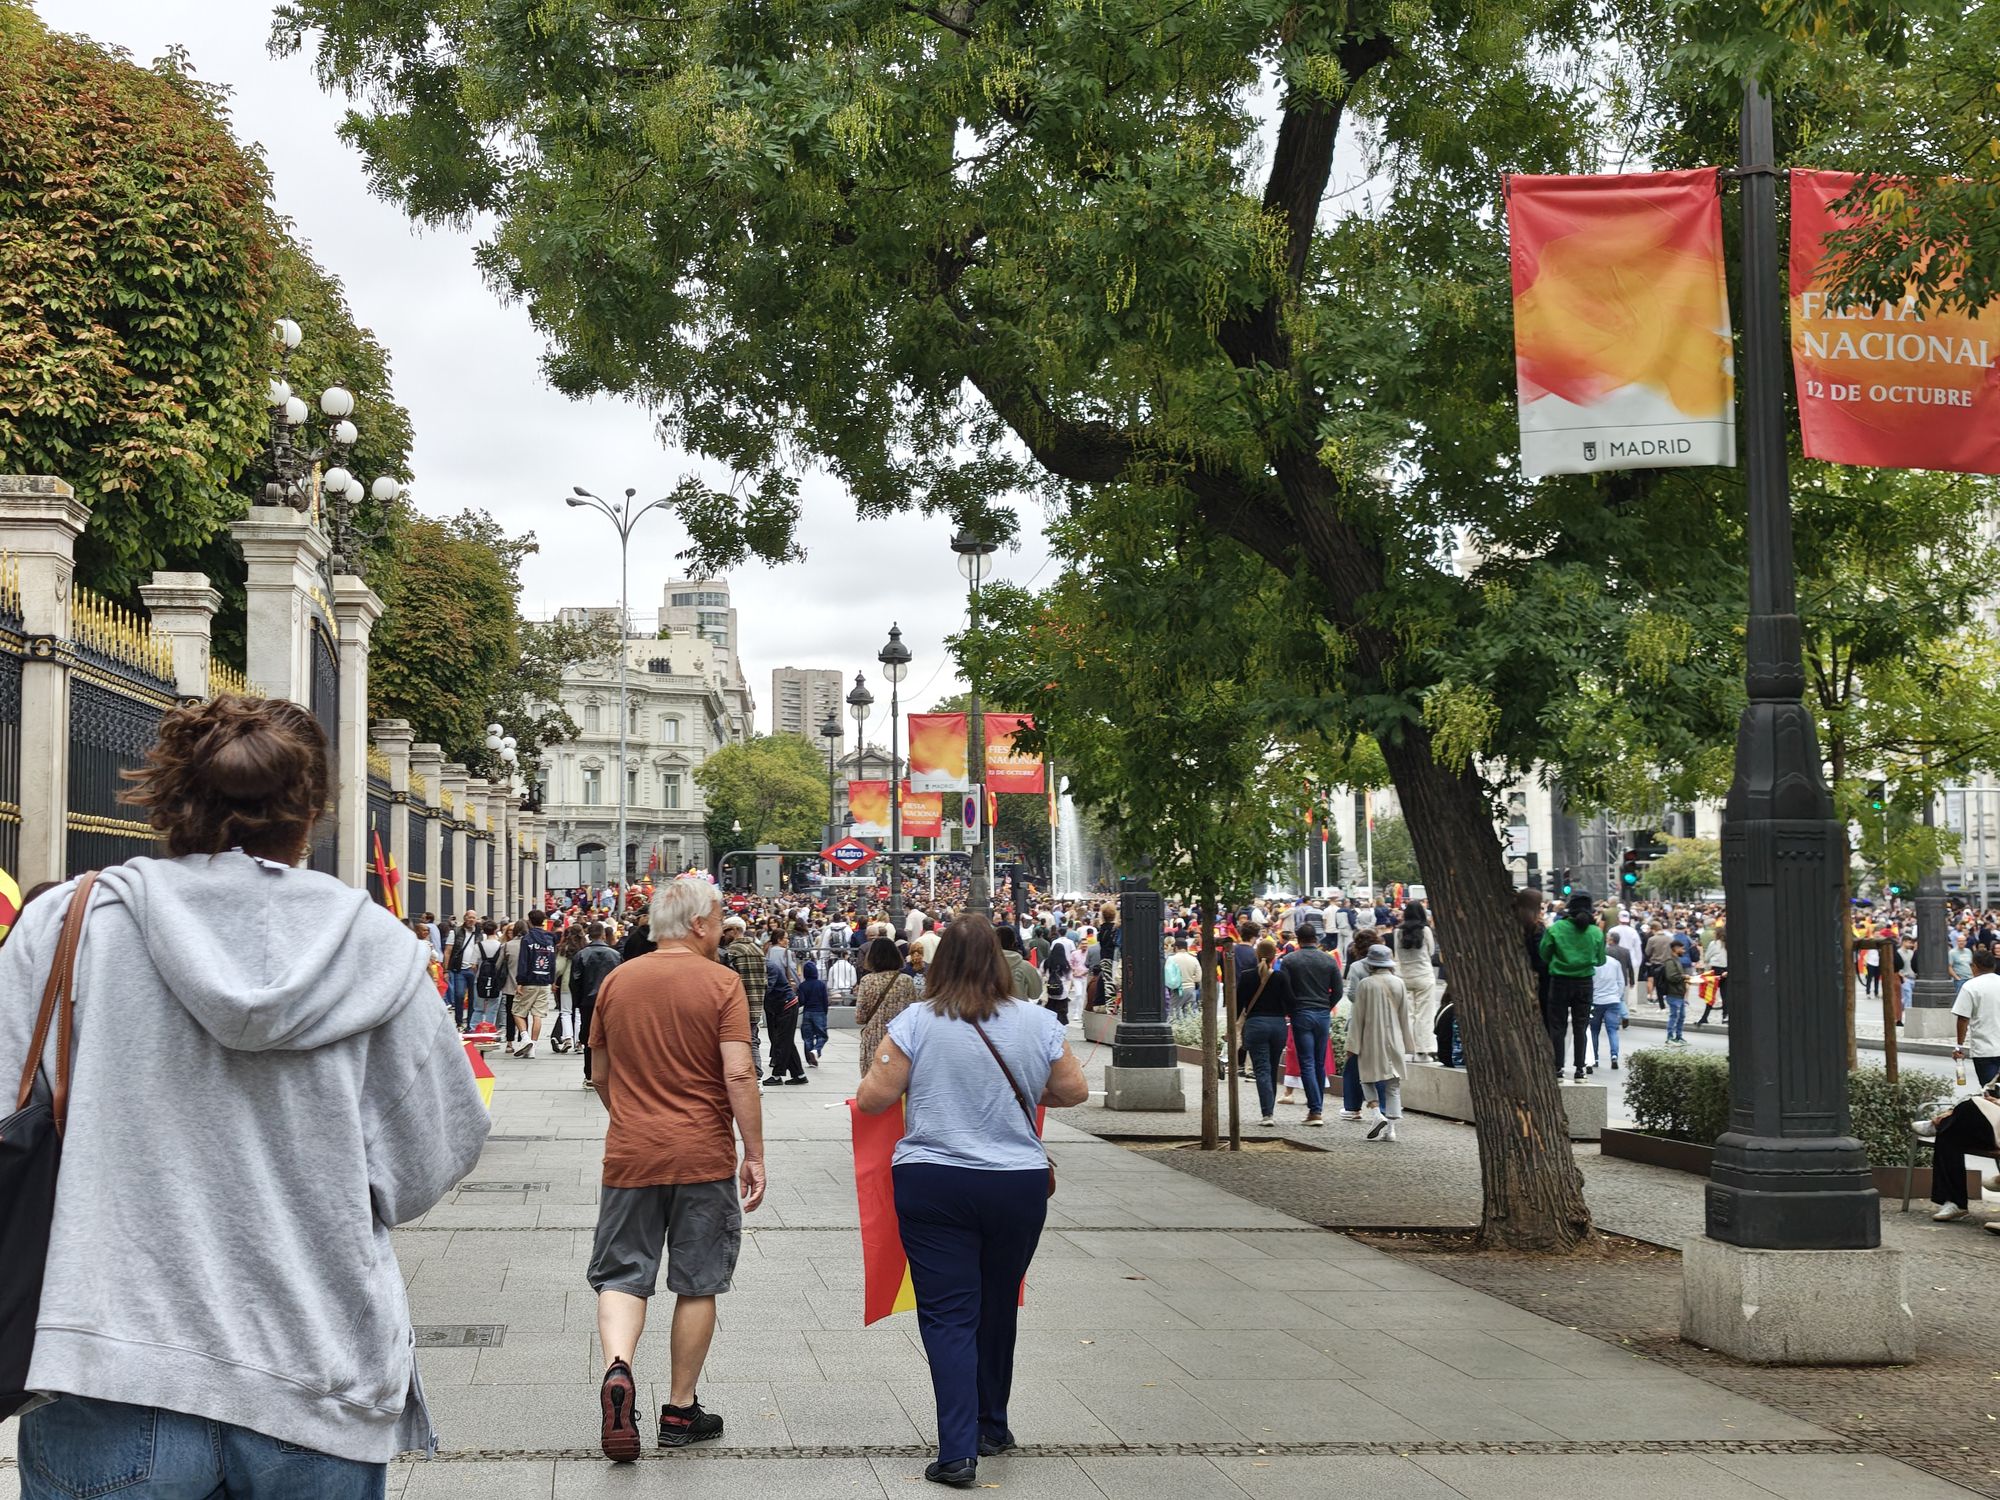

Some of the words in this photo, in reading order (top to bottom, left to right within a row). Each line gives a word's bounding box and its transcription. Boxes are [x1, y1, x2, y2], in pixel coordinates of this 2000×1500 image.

[1802, 331, 1996, 369] NACIONAL
[1805, 380, 1824, 399] 12
[1830, 383, 1862, 401] DE
[1868, 385, 1973, 408] OCTUBRE
[1610, 438, 1692, 457] MADRID
[837, 849, 863, 858] Metro
